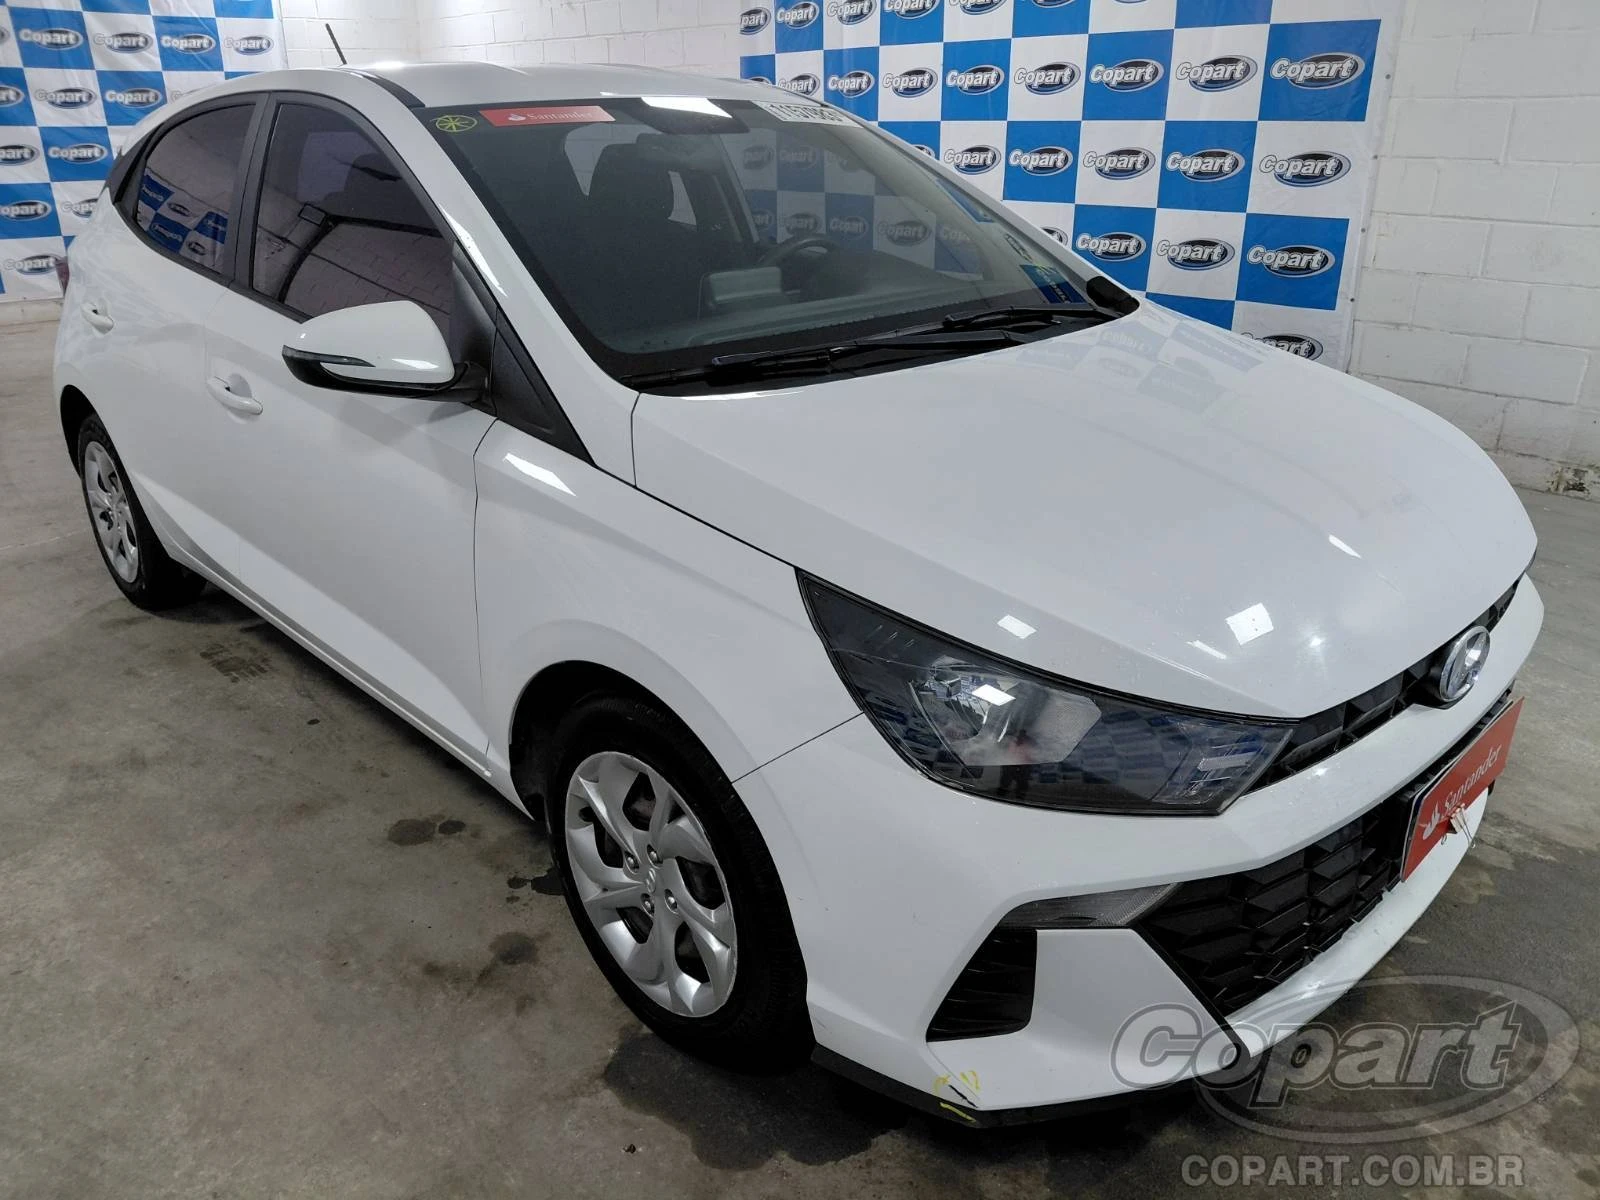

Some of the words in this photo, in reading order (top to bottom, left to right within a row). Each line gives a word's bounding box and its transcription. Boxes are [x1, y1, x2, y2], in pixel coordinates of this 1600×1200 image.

[740, 12, 766, 28] part
[776, 7, 814, 25] Copart
[827, 0, 870, 20] Copart
[19, 28, 78, 46] Copart
[93, 33, 147, 48] Copart
[160, 34, 210, 49] Copart
[224, 38, 269, 51] Copart
[946, 69, 999, 90] Copart
[1013, 67, 1073, 89] Copart
[1090, 61, 1155, 84] Copart
[1175, 59, 1246, 85] Copart
[1270, 55, 1355, 85] Copart
[828, 75, 869, 92] Copart
[882, 72, 930, 92] Copart
[34, 89, 88, 103] Copart
[105, 90, 156, 104] Copart
[48, 146, 100, 161] Copart
[944, 148, 996, 168] Copart
[1008, 149, 1067, 170] Copart
[1083, 151, 1148, 177] Copart
[1165, 153, 1235, 178] Copart
[1258, 154, 1340, 181] Copart
[0, 203, 44, 217] opart
[61, 201, 98, 214] Copa
[1075, 232, 1139, 257] Copart
[1155, 239, 1228, 266] Copart
[4, 257, 56, 271] Copart
[1247, 244, 1328, 271] Copart
[1444, 744, 1502, 811] Santander
